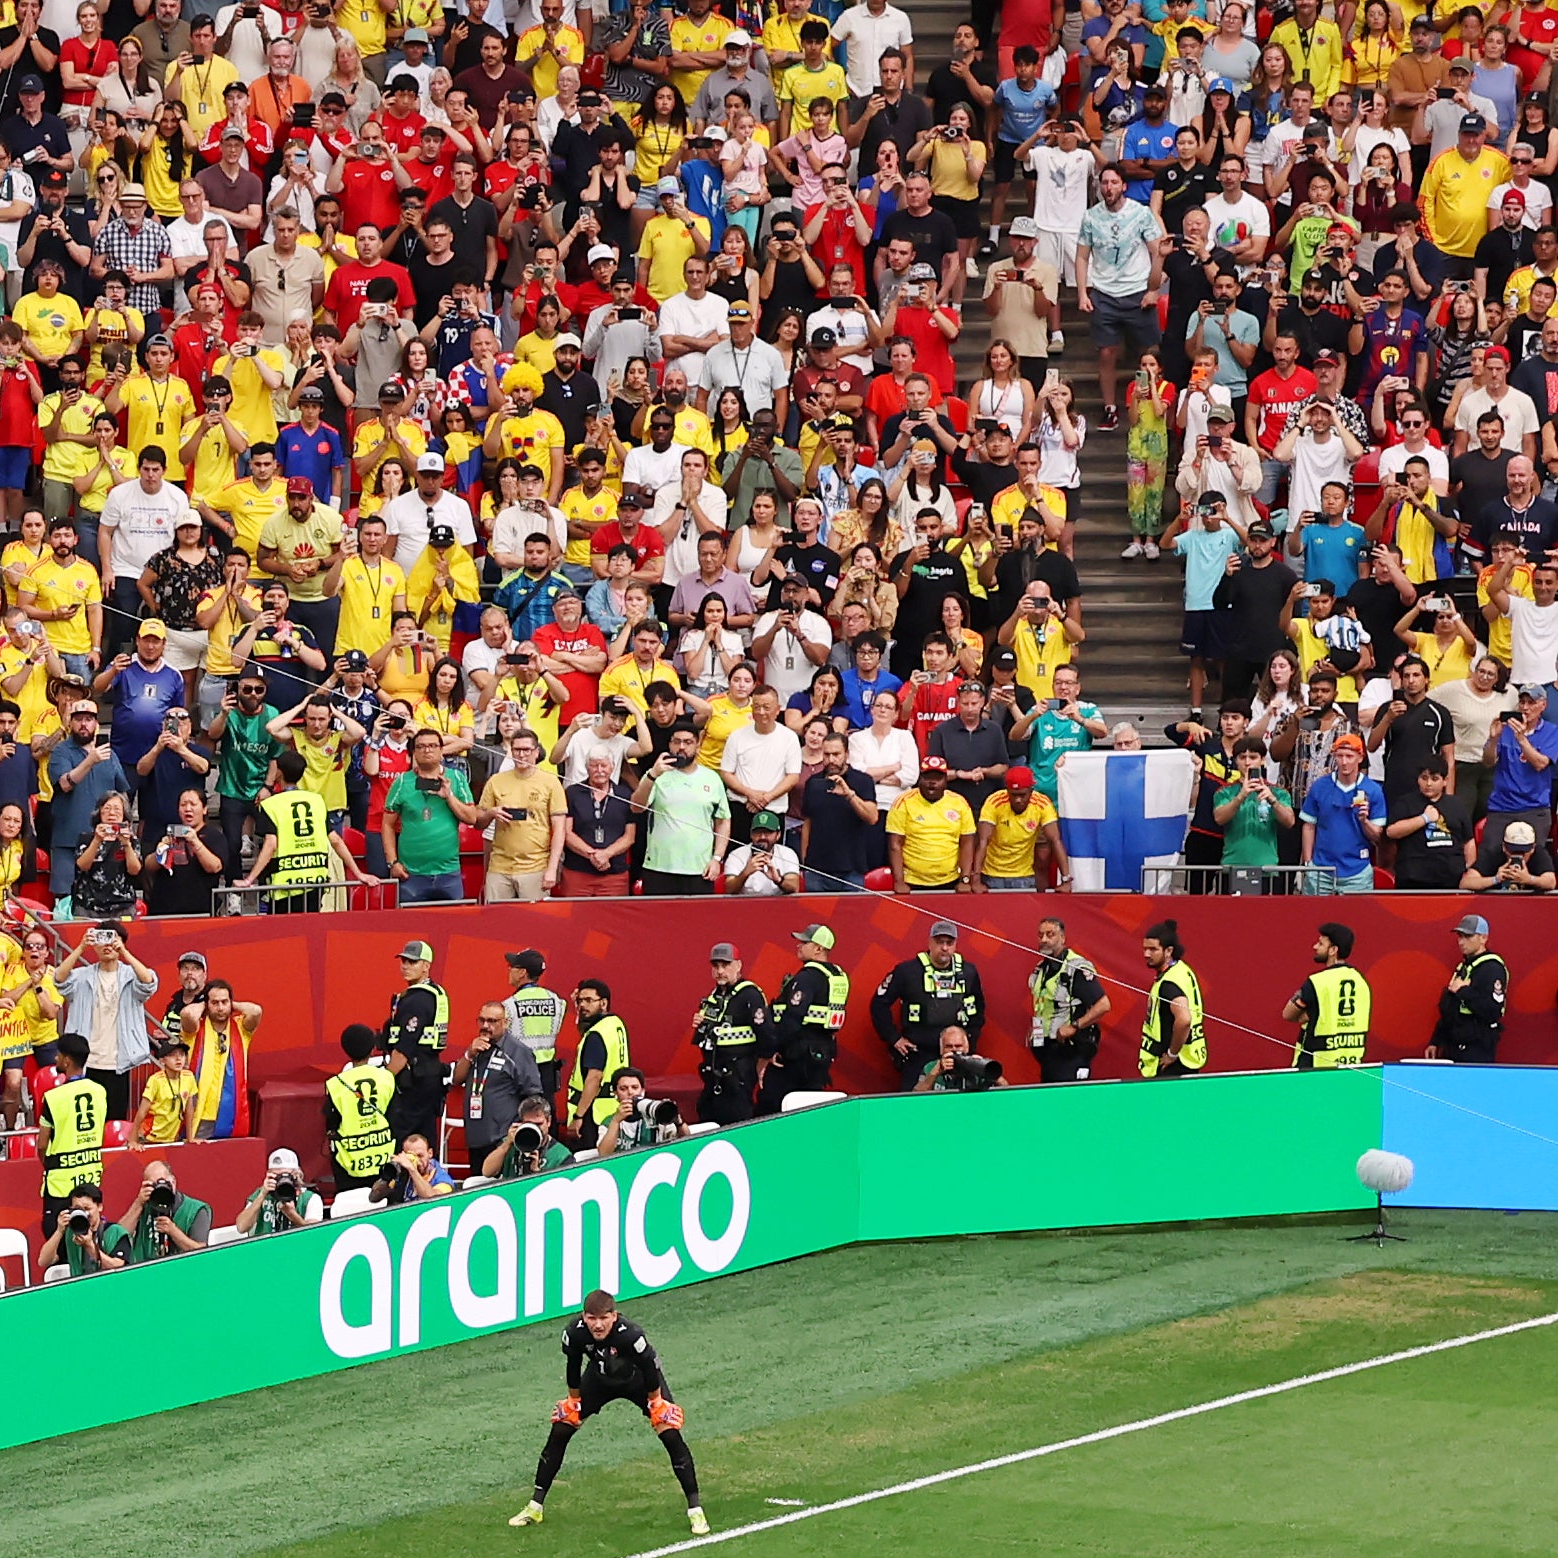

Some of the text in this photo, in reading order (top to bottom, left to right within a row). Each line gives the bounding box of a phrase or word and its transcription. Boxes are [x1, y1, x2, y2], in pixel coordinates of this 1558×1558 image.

[1113, 247, 1121, 264] 7
[443, 327, 458, 344] 19
[414, 402, 425, 417] 14
[277, 852, 329, 870] SECURITY
[517, 1005, 556, 1017] POLICE
[340, 1129, 392, 1151] SECURITY
[319, 1140, 751, 1359] aramco
[598, 1360, 607, 1376] 1
